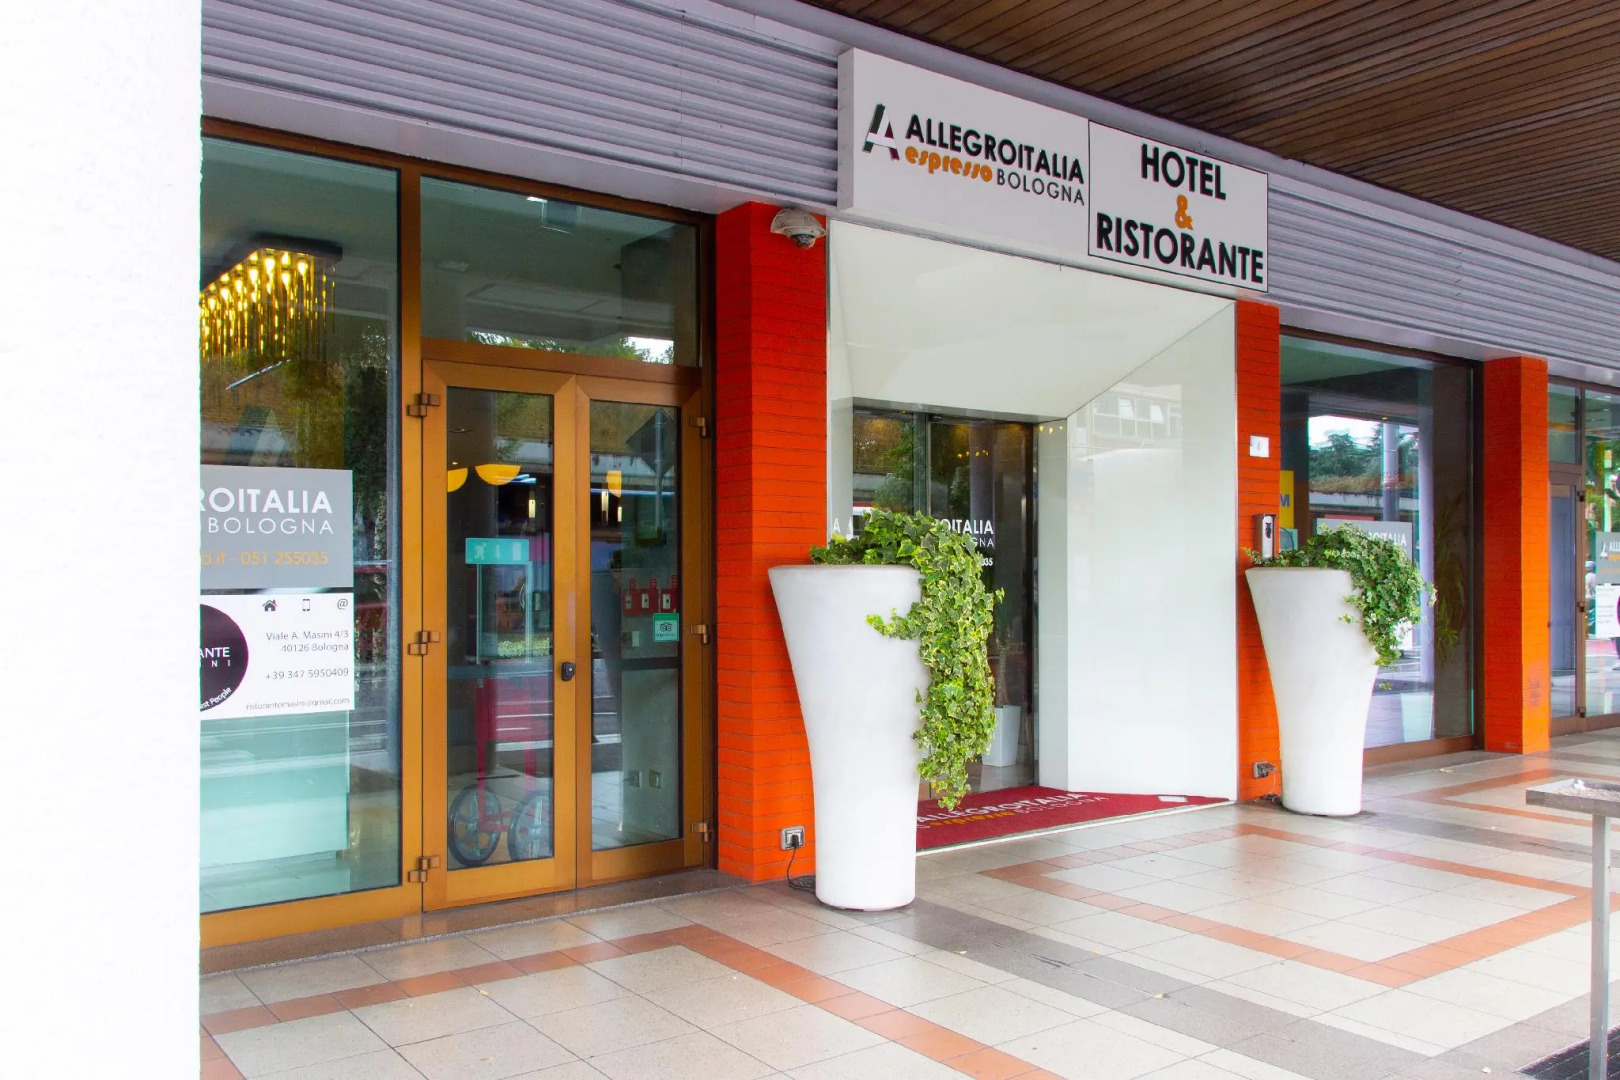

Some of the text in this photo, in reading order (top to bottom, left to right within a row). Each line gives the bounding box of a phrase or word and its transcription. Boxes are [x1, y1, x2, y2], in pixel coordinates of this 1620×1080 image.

[905, 114, 1085, 184] ALLEGROITALIA
[905, 146, 1085, 206] espresso BOLOGNA
[1140, 143, 1227, 200] HOTEL
[1175, 194, 1194, 230] &
[1096, 212, 1264, 284] RISTORANTE
[208, 517, 334, 535] BOLOGNA
[240, 551, 268, 566] 051
[274, 551, 329, 566] 255035
[266, 632, 289, 641] Viale
[303, 630, 333, 640] Masini
[333, 630, 349, 639] 4/3
[281, 643, 349, 653] 40126 Bologna
[266, 668, 349, 681] +39 347 5950409
[209, 686, 232, 705] People
